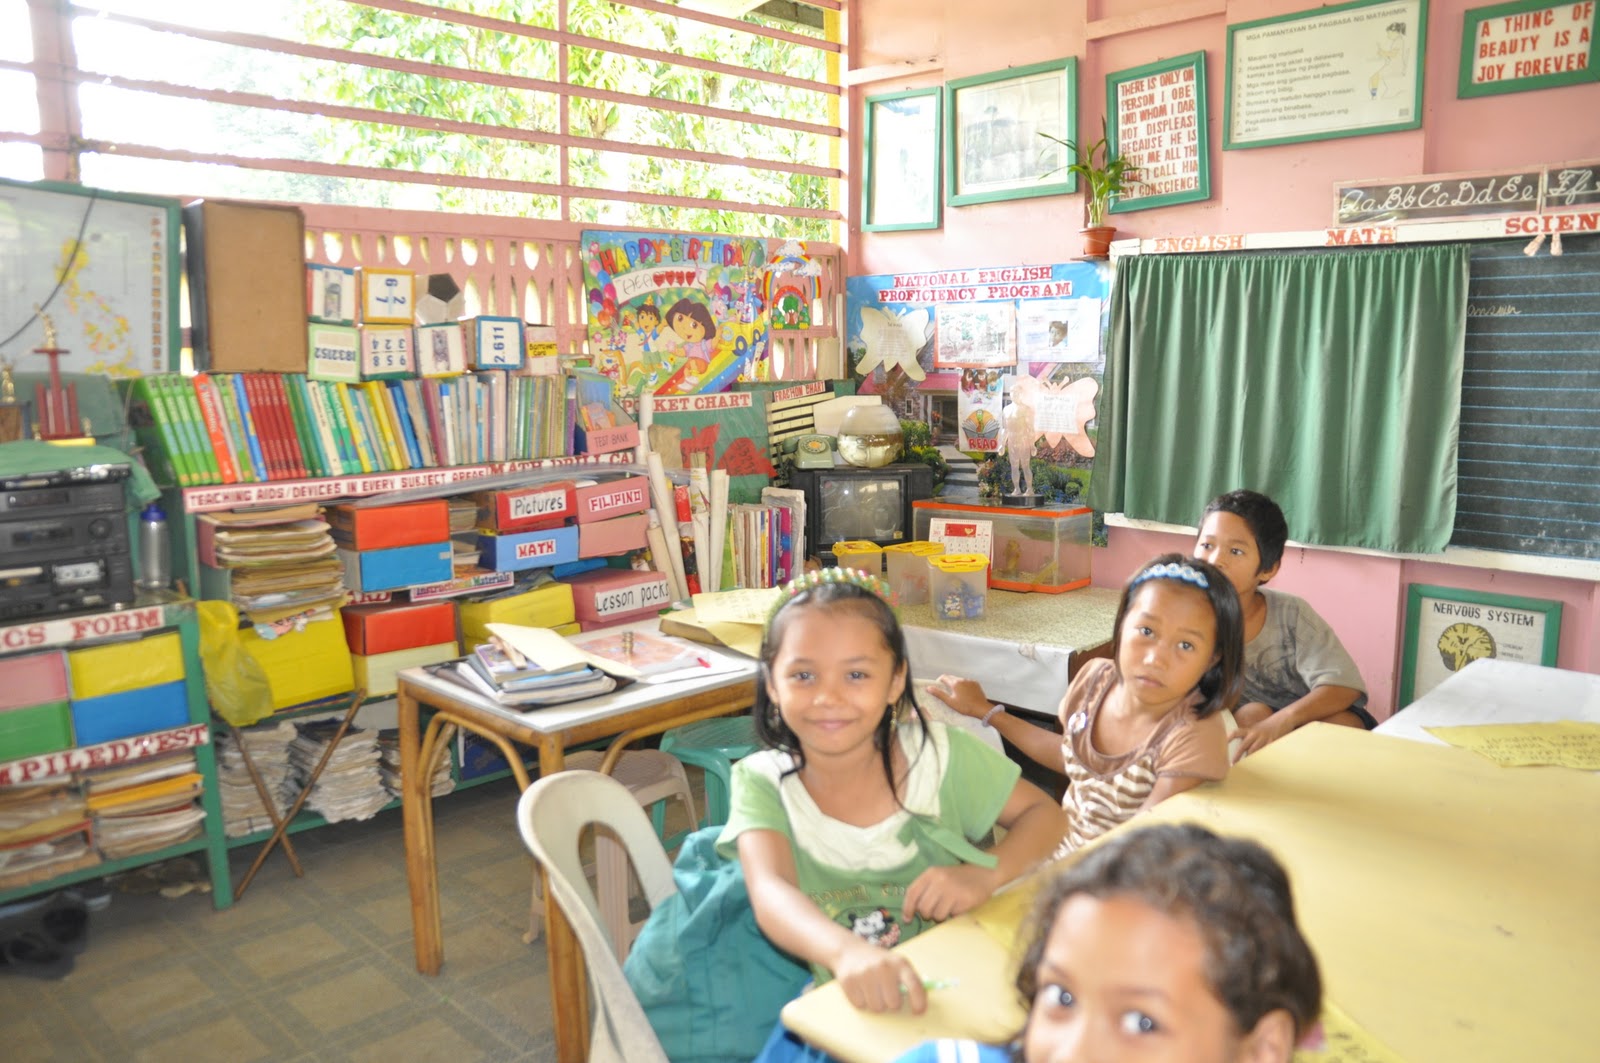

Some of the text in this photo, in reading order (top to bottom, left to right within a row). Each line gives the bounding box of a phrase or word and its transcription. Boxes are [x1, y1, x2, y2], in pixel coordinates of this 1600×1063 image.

[1481, 1, 1593, 37] A THING OF
[1479, 26, 1590, 59] BEAUTY IS A
[1477, 52, 1587, 82] JOY FOREVER
[1121, 80, 1144, 96] THERE
[1148, 78, 1157, 91] IS
[1160, 71, 1180, 87] ONLY
[1121, 94, 1155, 112] PERSON
[1122, 110, 1137, 126] AND
[1140, 105, 1167, 121] WHOM
[1121, 127, 1138, 141] NOT
[1121, 129, 1197, 154] BECAUSE HE IS
[1148, 151, 1161, 163] ME
[1165, 148, 1181, 161] ALL
[1154, 163, 1177, 178] CALL
[1139, 175, 1199, 196] CONSCIENCE
[1154, 234, 1244, 252] ENGLISH
[1325, 226, 1396, 246] MATH
[600, 237, 664, 274] HAPPY
[894, 266, 1052, 288] NATIONAL ENGLISH
[879, 282, 1071, 302] PROFICIENCY PROGRAM
[805, 381, 826, 396] CHART
[621, 394, 750, 413] POKET CHART
[594, 436, 610, 448] TEST
[968, 437, 998, 450] READ
[191, 489, 252, 507] TEACHING
[347, 481, 357, 492] IN
[362, 479, 395, 492] EVERY
[401, 473, 446, 489] SUBJECT
[590, 490, 642, 511] FILIPINO
[514, 494, 564, 516] Pictures
[518, 540, 556, 557] MATH
[596, 582, 670, 613] Lesson packs
[71, 609, 161, 640] FORM
[1433, 602, 1534, 627] NERVOUS SYSTEM
